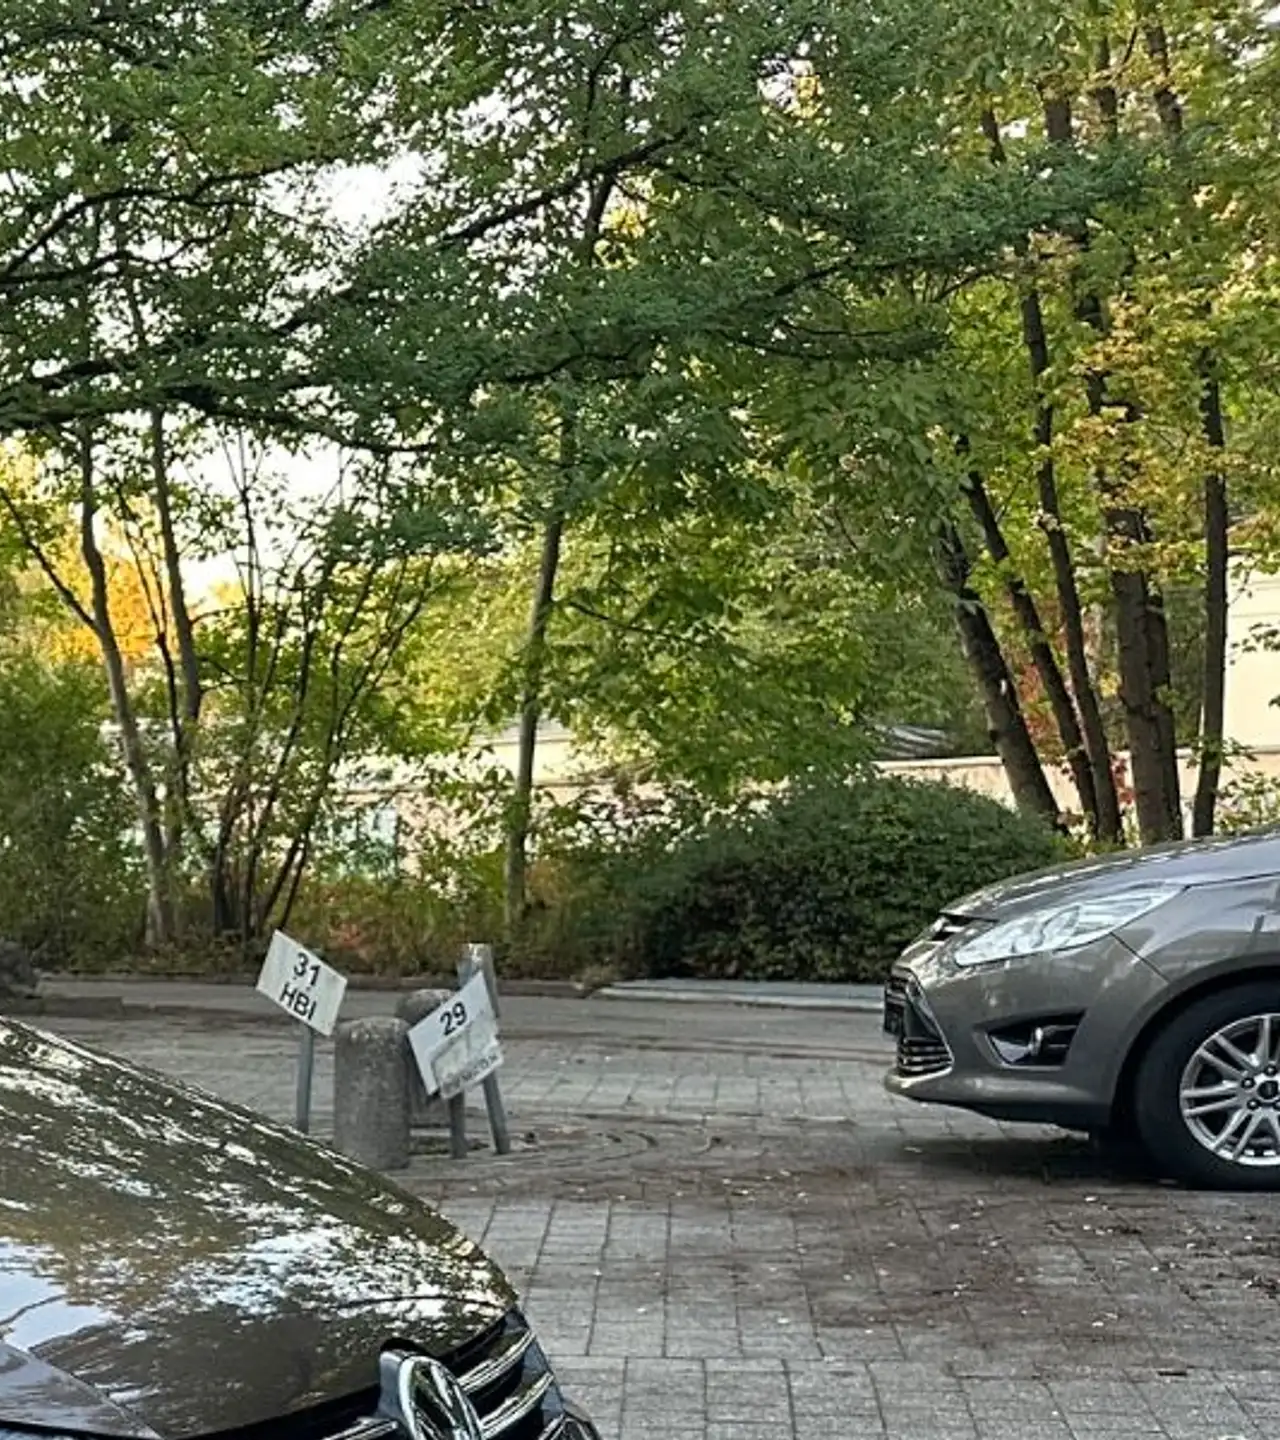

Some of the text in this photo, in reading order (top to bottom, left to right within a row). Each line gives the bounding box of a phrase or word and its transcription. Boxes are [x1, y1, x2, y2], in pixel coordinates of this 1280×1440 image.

[293, 952, 321, 986] 31
[280, 981, 317, 1020] HBI
[440, 1002, 467, 1036] 29
